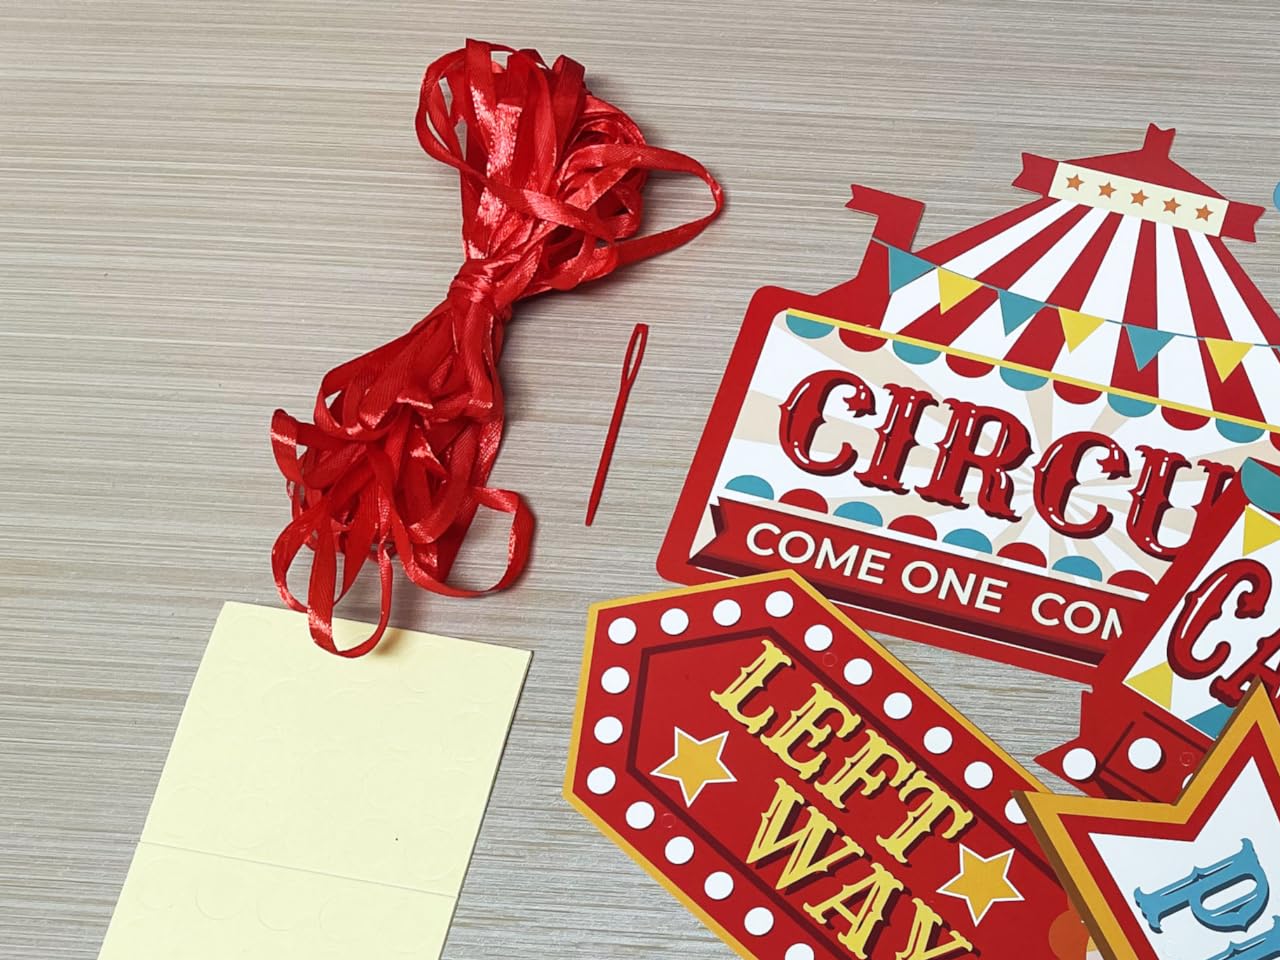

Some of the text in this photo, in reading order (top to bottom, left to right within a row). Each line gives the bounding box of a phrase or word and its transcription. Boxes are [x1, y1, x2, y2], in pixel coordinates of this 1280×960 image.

[746, 522, 892, 585] COME
[901, 560, 1009, 614] ONE
[710, 639, 974, 864] LEFT
